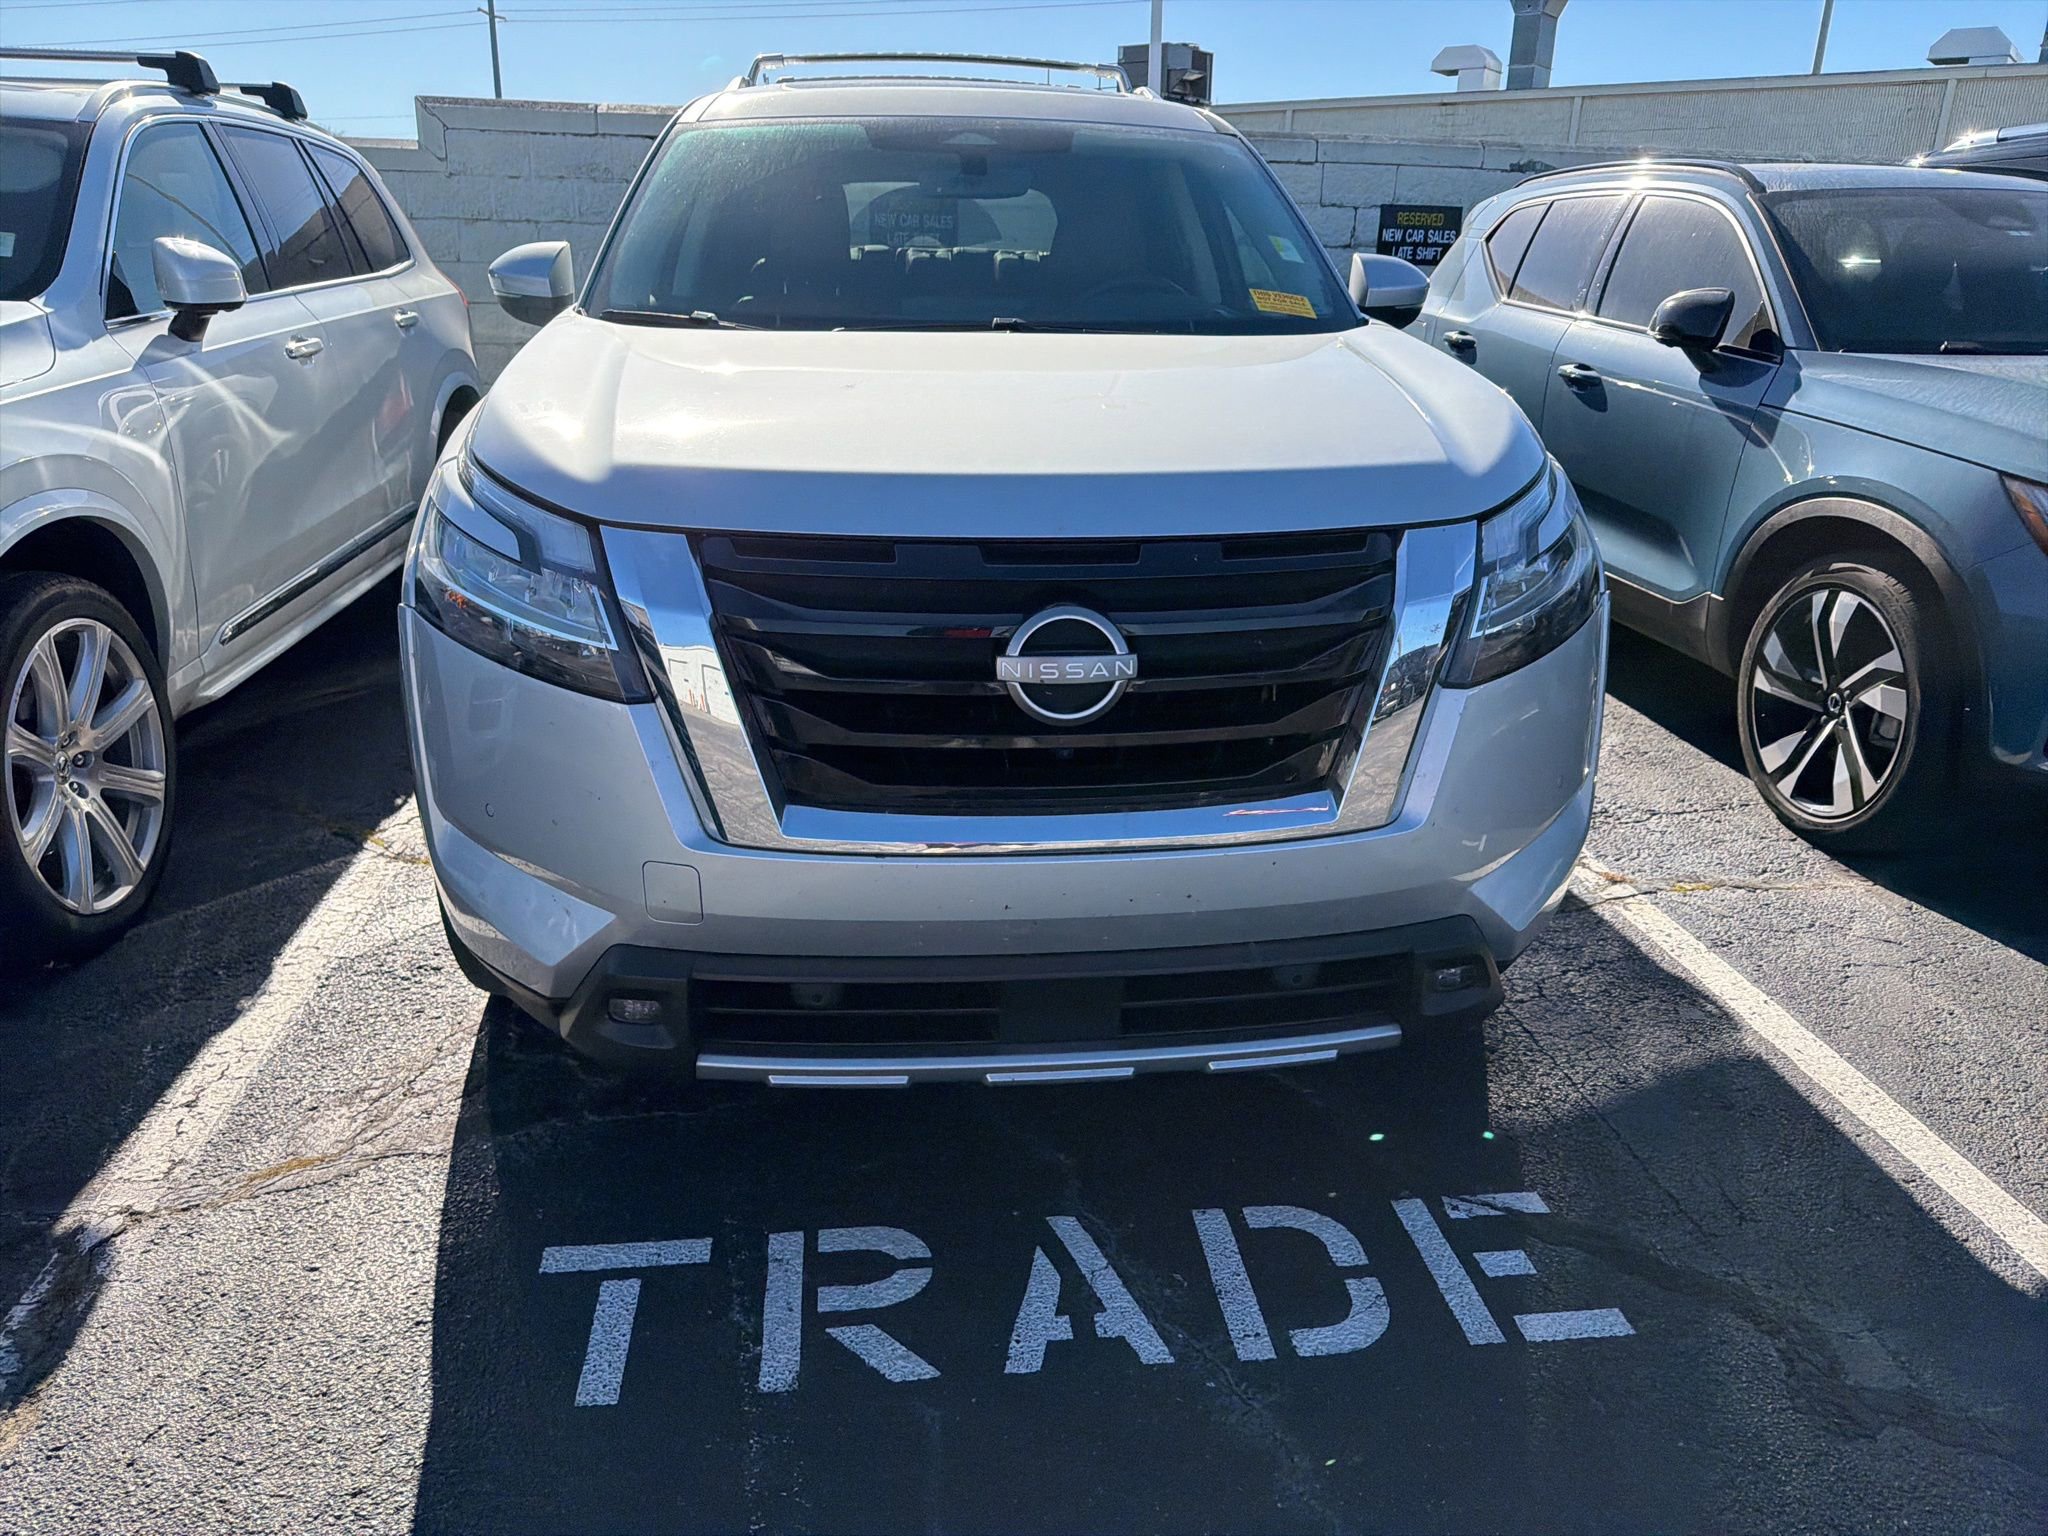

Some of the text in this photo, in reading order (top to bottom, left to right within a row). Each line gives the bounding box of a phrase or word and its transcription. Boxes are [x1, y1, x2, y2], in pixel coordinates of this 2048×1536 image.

[1397, 211, 1444, 226] RESERVED
[1382, 228, 1457, 244] NEW CAR SALES
[1391, 246, 1443, 261] LATE SHIFT
[1001, 660, 1134, 679] NISSAN
[539, 1191, 1636, 1406] TRADE
